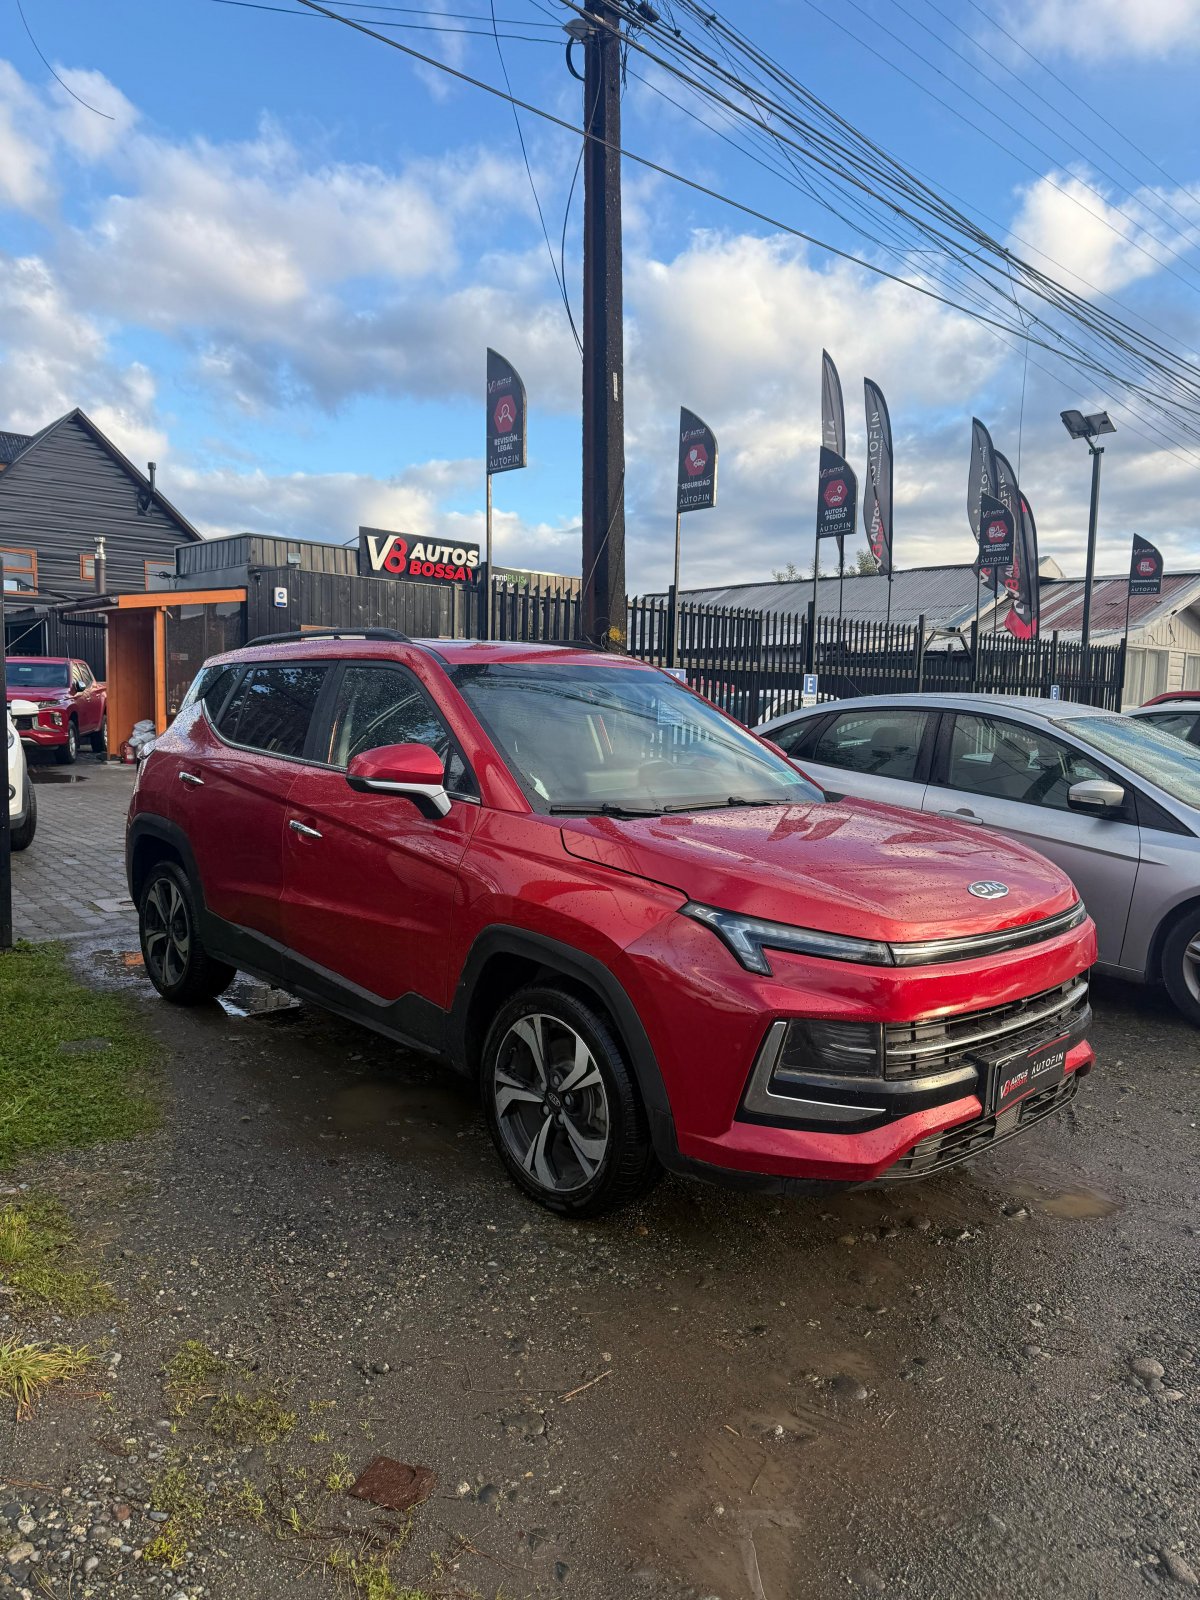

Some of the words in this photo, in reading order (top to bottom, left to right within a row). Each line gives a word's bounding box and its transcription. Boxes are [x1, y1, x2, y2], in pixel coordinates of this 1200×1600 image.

[494, 433, 517, 446] REVISIÓN
[498, 443, 513, 452] LEGAL
[490, 454, 520, 468] AUTOFIN
[681, 479, 711, 490] SEGURIDAD
[680, 494, 710, 505] AUTOFIN
[824, 507, 842, 516] AUTOS
[825, 512, 846, 521] PEDIDO
[819, 522, 851, 533] AUTOFIN
[367, 534, 408, 574] V8
[409, 542, 479, 567] AUTOS
[807, 677, 814, 692] E
[1052, 687, 1057, 699] E
[1010, 1069, 1029, 1085] AUTOS
[1031, 1052, 1064, 1075] AUTOFIN
